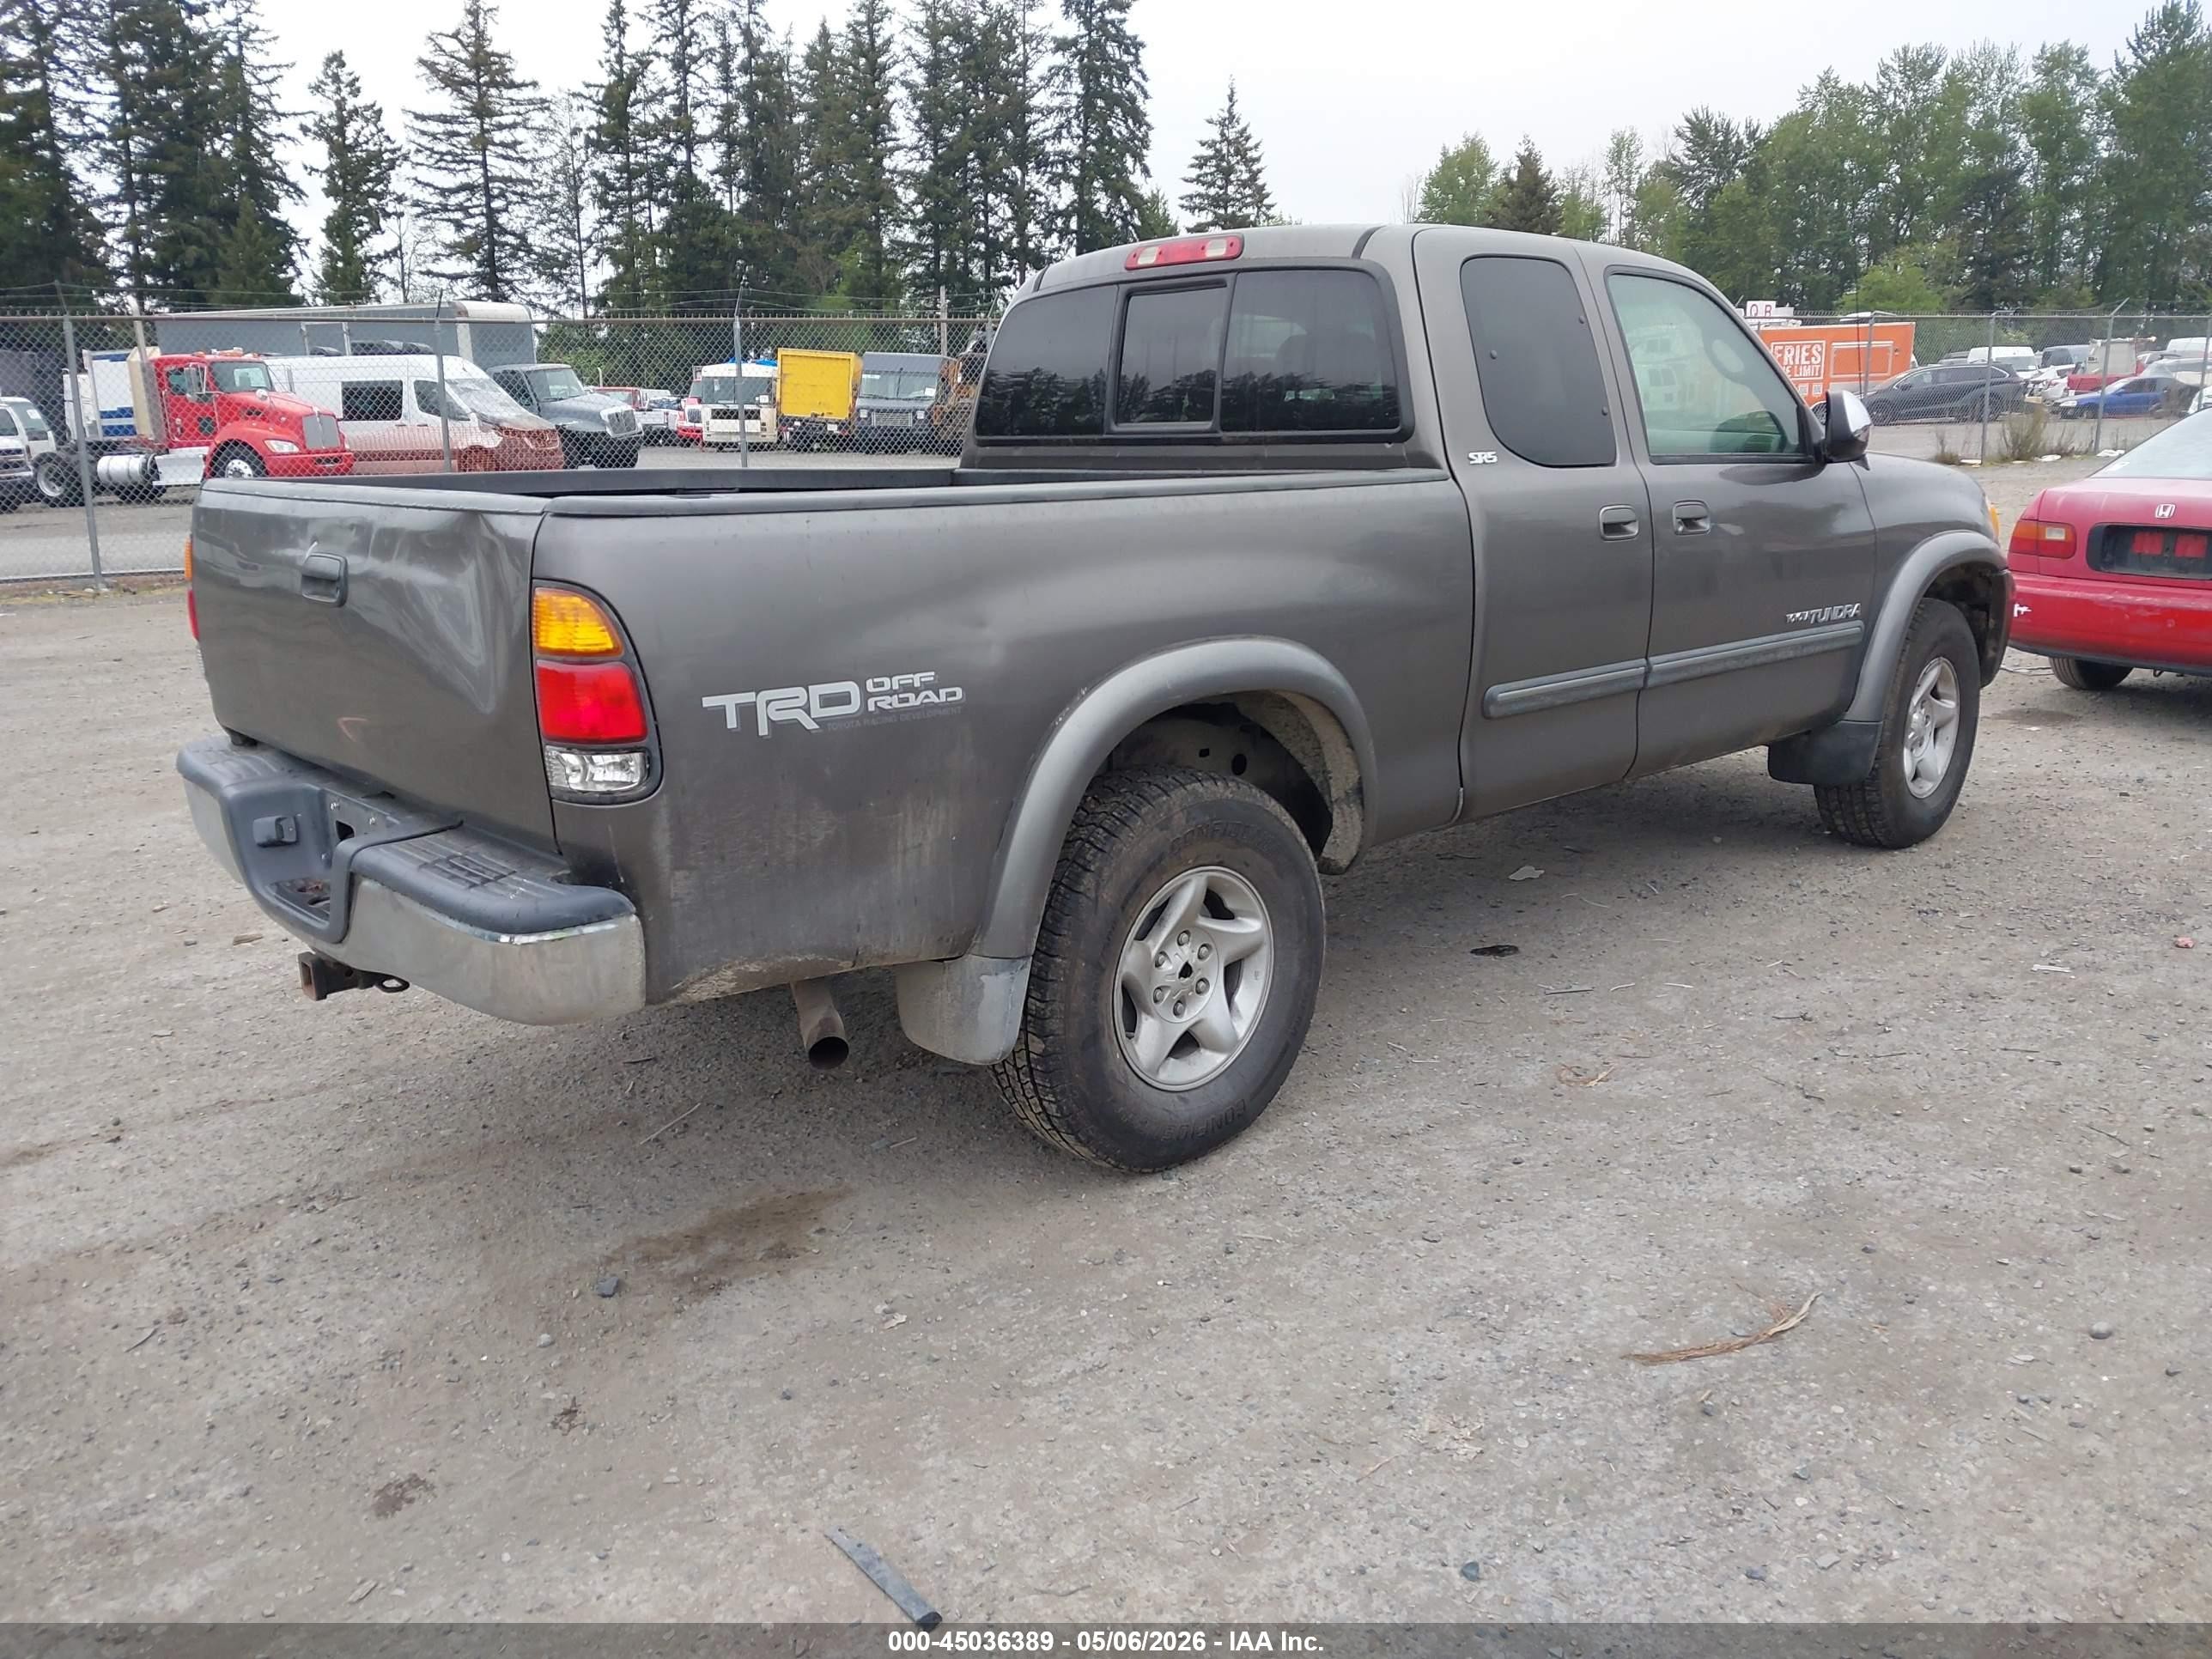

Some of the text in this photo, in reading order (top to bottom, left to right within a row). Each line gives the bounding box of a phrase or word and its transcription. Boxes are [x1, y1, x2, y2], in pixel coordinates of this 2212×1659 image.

[1774, 343, 1822, 366] FRIES
[1794, 364, 1820, 377] LIMIT
[1808, 602, 1862, 624] TUNDRA
[866, 671, 936, 694] OFF
[702, 680, 861, 737] TRD
[867, 686, 963, 713] ROAD
